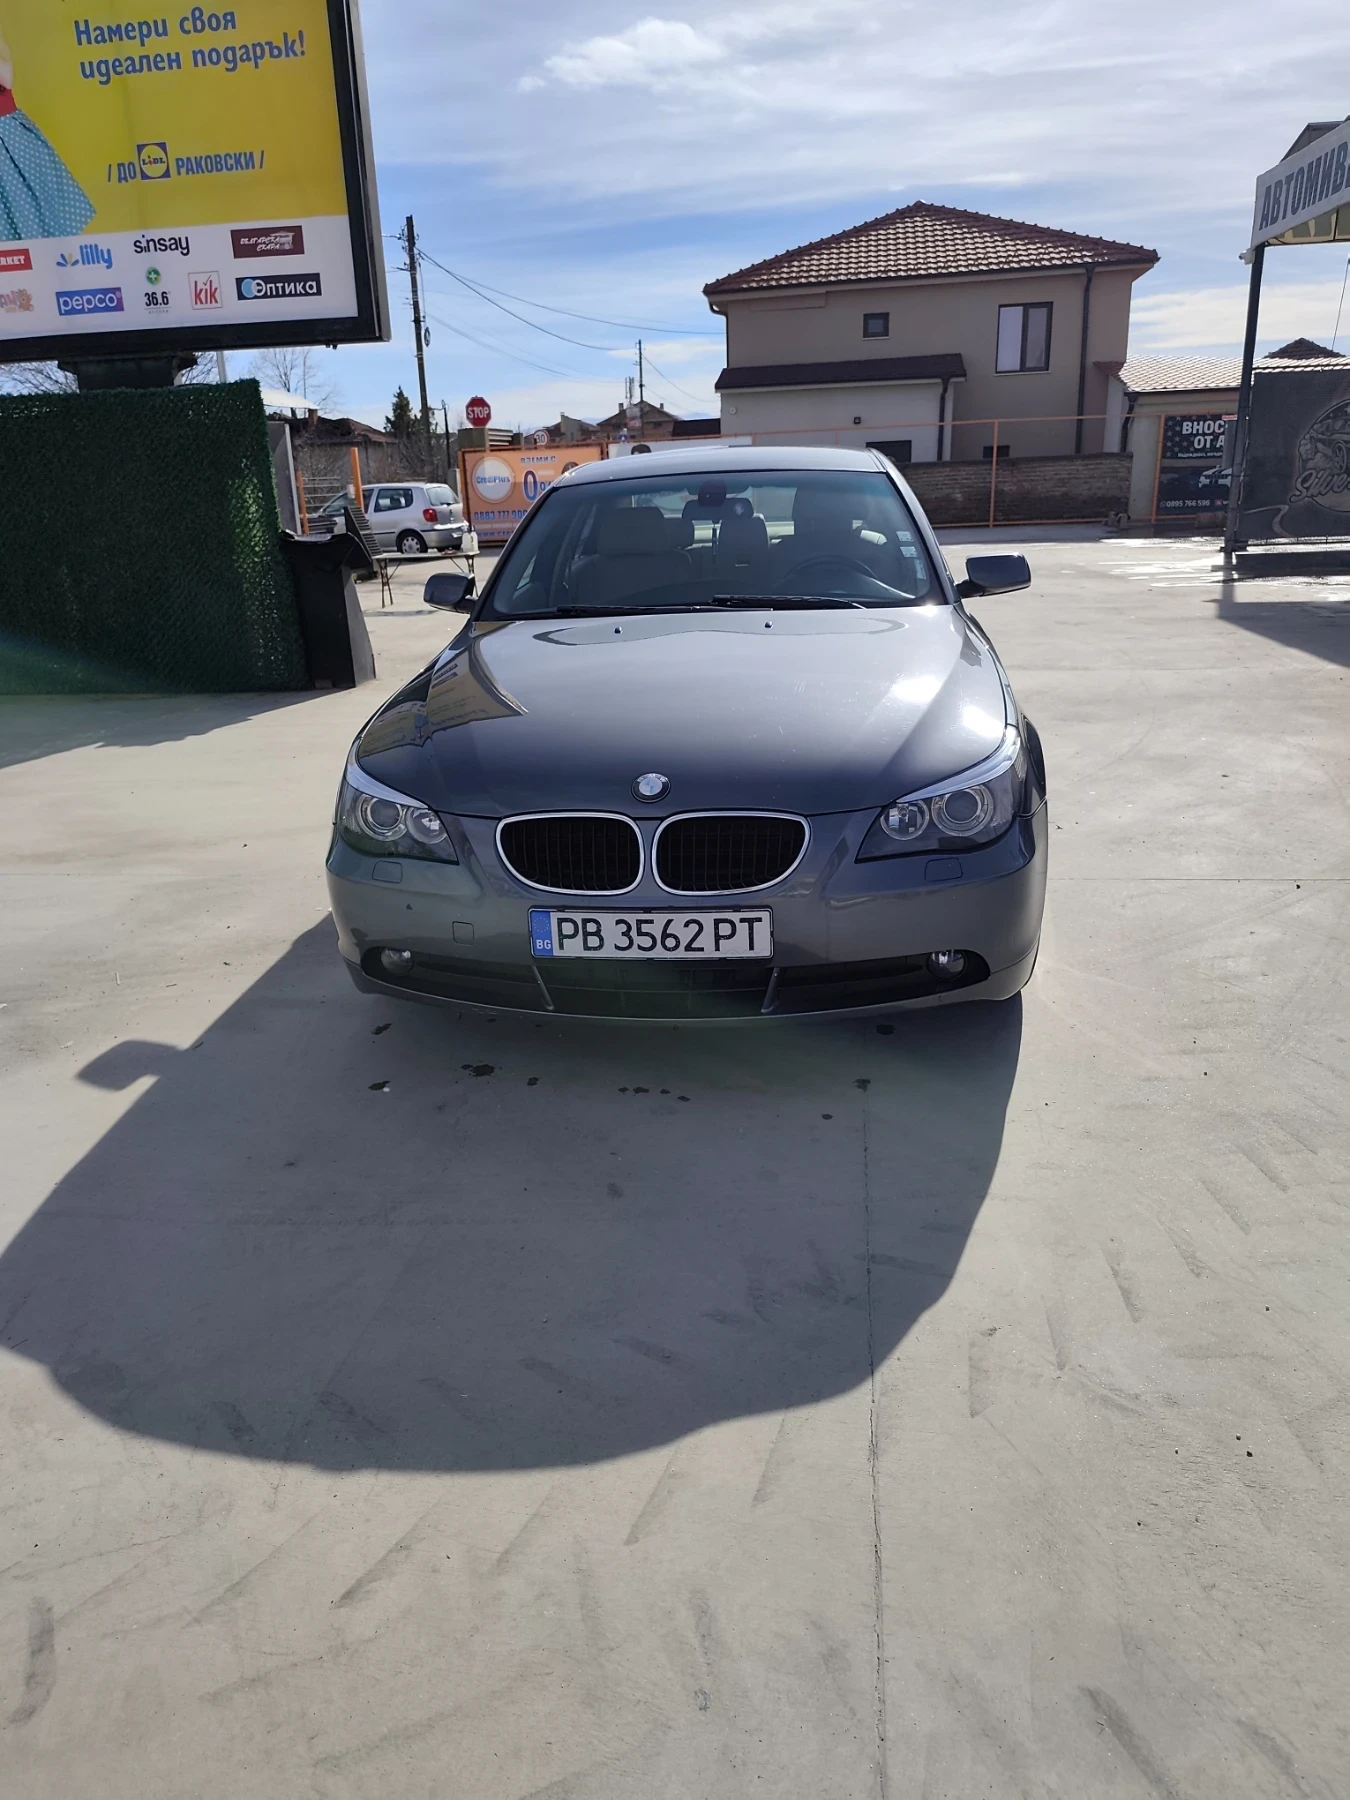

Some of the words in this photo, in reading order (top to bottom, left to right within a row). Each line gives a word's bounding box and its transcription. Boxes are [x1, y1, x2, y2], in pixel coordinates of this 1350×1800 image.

[74, 19, 169, 47] Намери
[179, 7, 236, 35] своя
[80, 50, 182, 85] идеален
[192, 30, 306, 73] подарък!
[117, 161, 137, 183] ДО
[175, 151, 256, 176] РАКОВСКИ
[79, 243, 113, 270] lilly
[133, 234, 191, 256] sinsay
[59, 293, 118, 314] pepco
[144, 291, 170, 307] 36.6
[194, 275, 219, 305] kik
[467, 407, 490, 419] STOP
[1193, 435, 1214, 449] ОТ
[1290, 469, 1350, 503] Silve
[536, 939, 552, 950] BG
[613, 917, 706, 953] 3562
